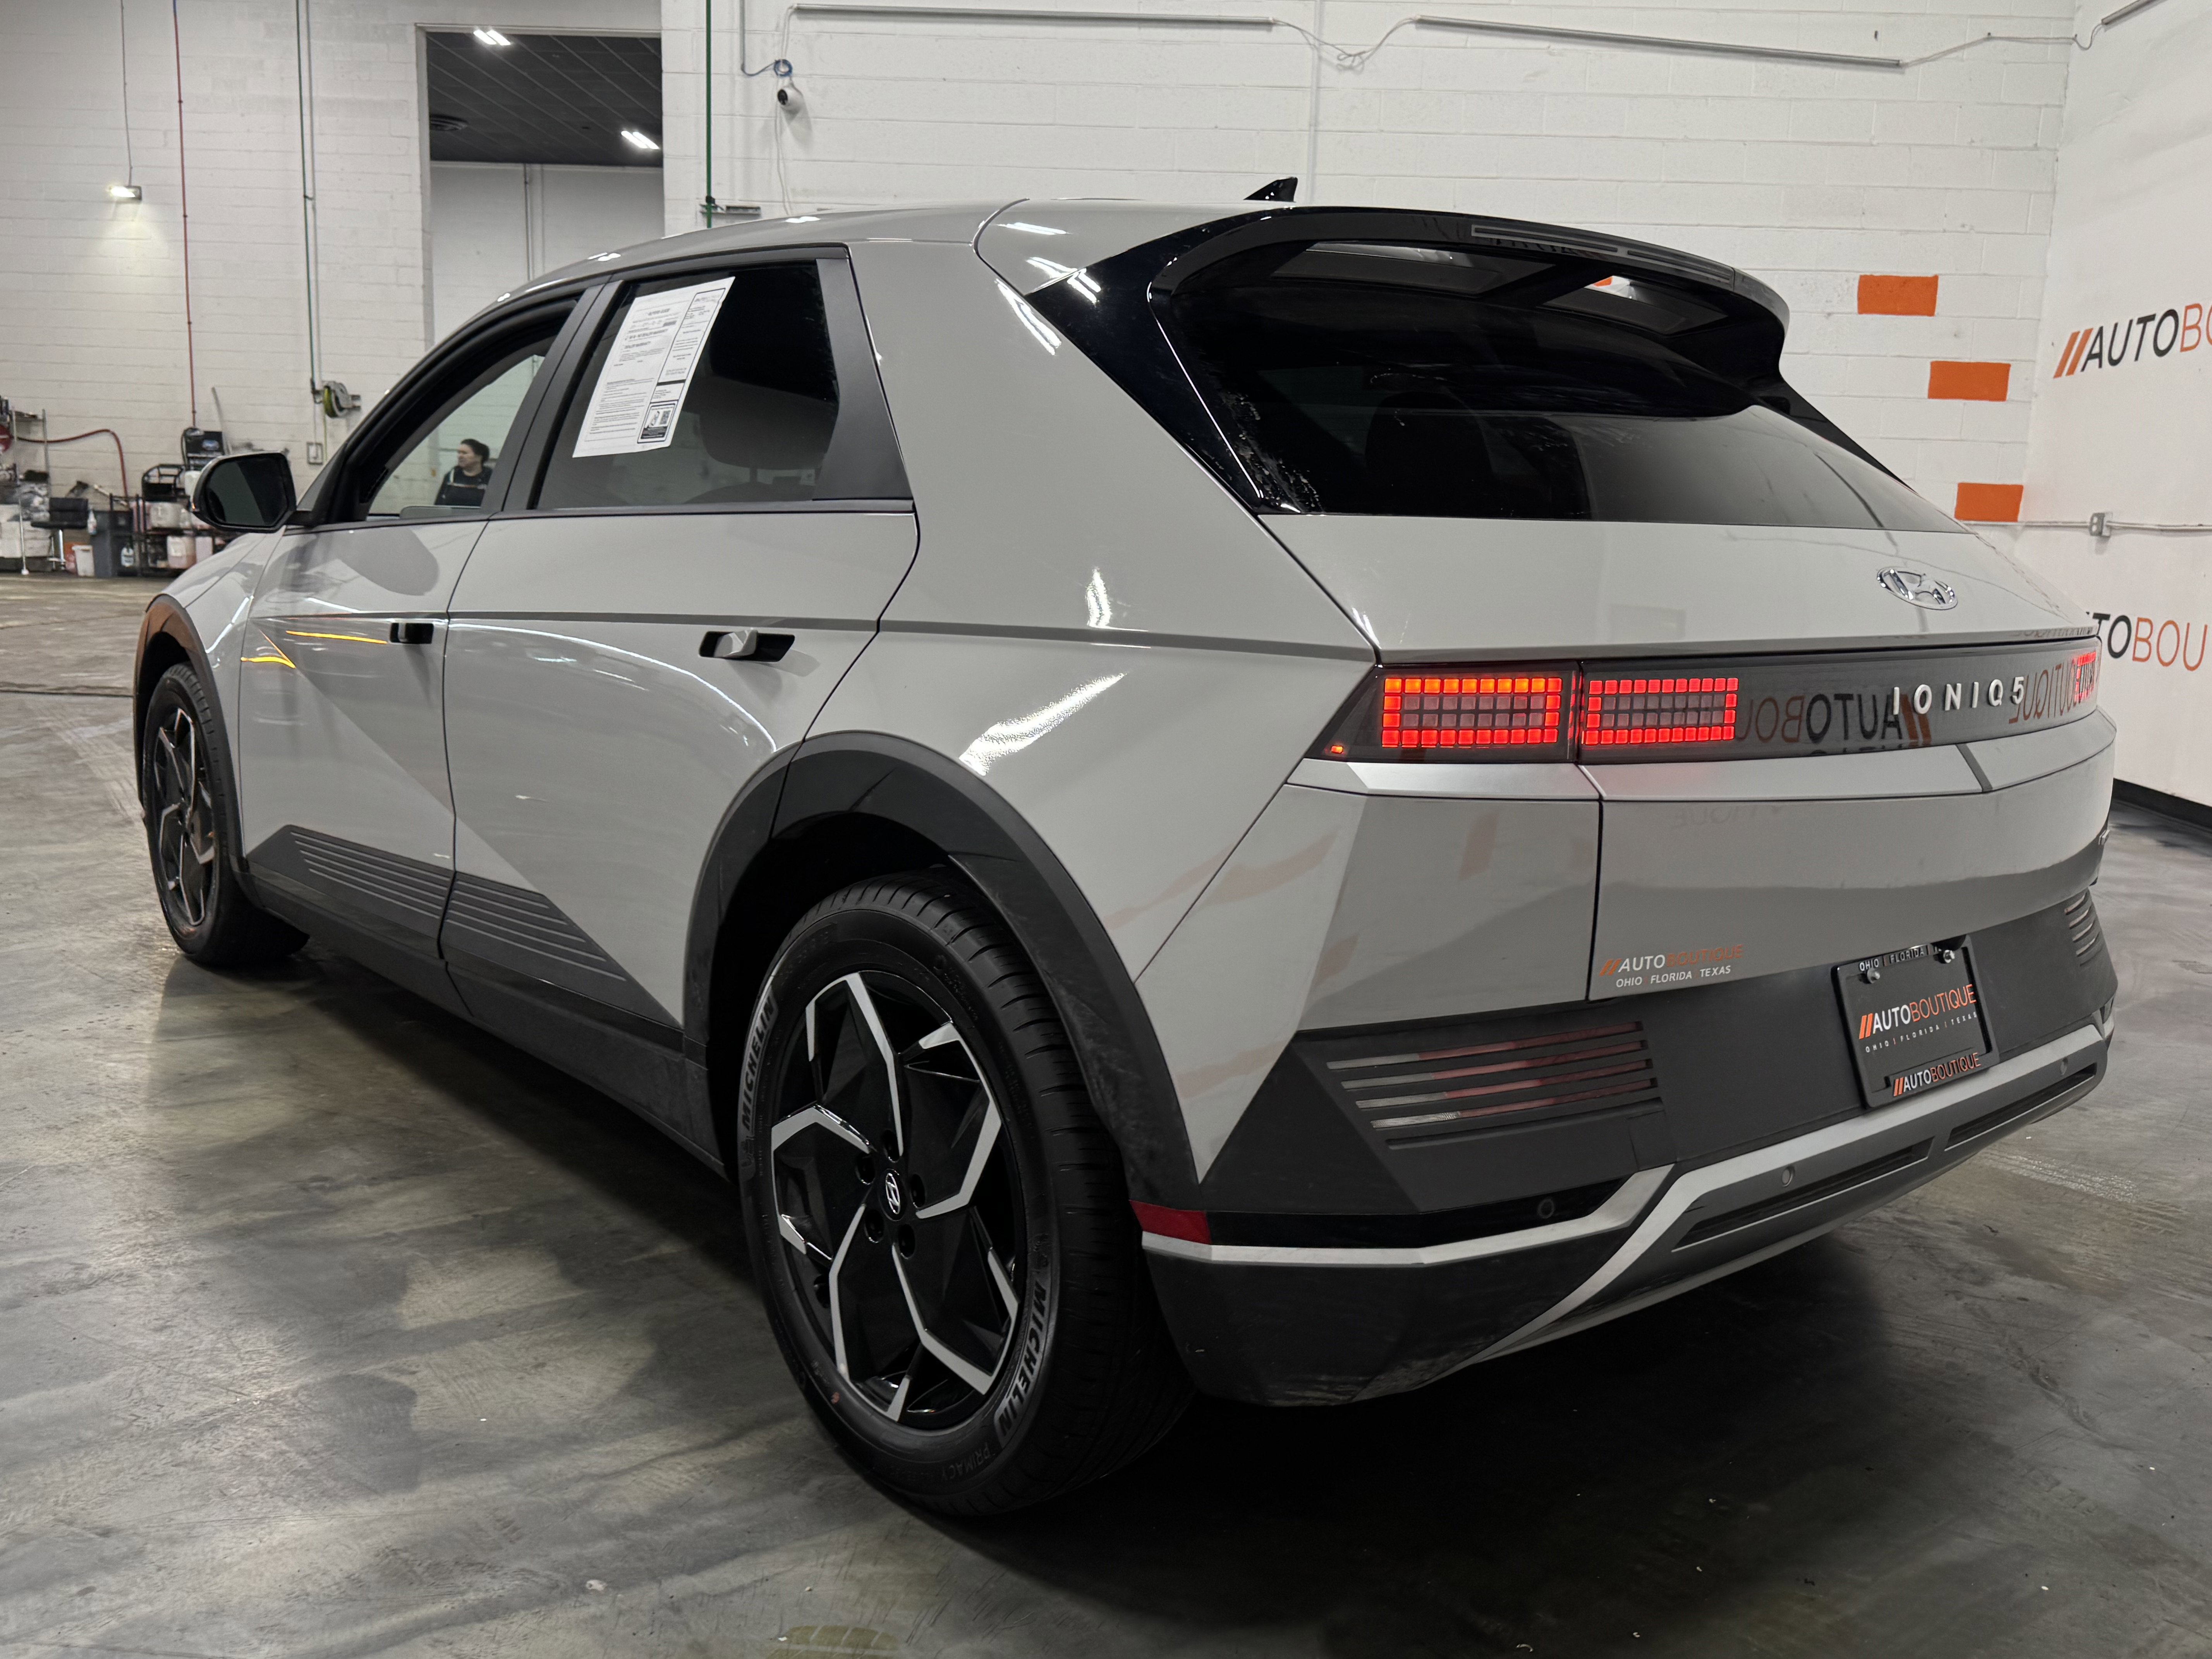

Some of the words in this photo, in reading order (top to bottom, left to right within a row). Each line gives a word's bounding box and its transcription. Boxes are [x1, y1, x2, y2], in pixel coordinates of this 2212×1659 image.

[2080, 303, 2212, 372] AUTOB
[1893, 679, 2003, 715] IONIQ
[2012, 677, 2024, 704] 5
[1616, 976, 1642, 988] OHIO
[1650, 970, 1692, 984] FLORIDA
[1699, 965, 1731, 977] TEXAS
[1618, 944, 1744, 973] AUTOBOUTIQUE
[1859, 958, 1879, 972] OHIO
[1890, 947, 1925, 964] FLORIDA
[1873, 984, 1977, 1034] AUTOBOUTIQUE
[1865, 1040, 1889, 1053] OHIO
[1900, 1025, 1939, 1042] FLORIDA
[1951, 1011, 1977, 1025] TEXAS
[742, 996, 774, 1131] MICHELIN
[1903, 1053, 1981, 1092] AUTOBOUTIQUE
[999, 1281, 1047, 1437] MICHELIN
